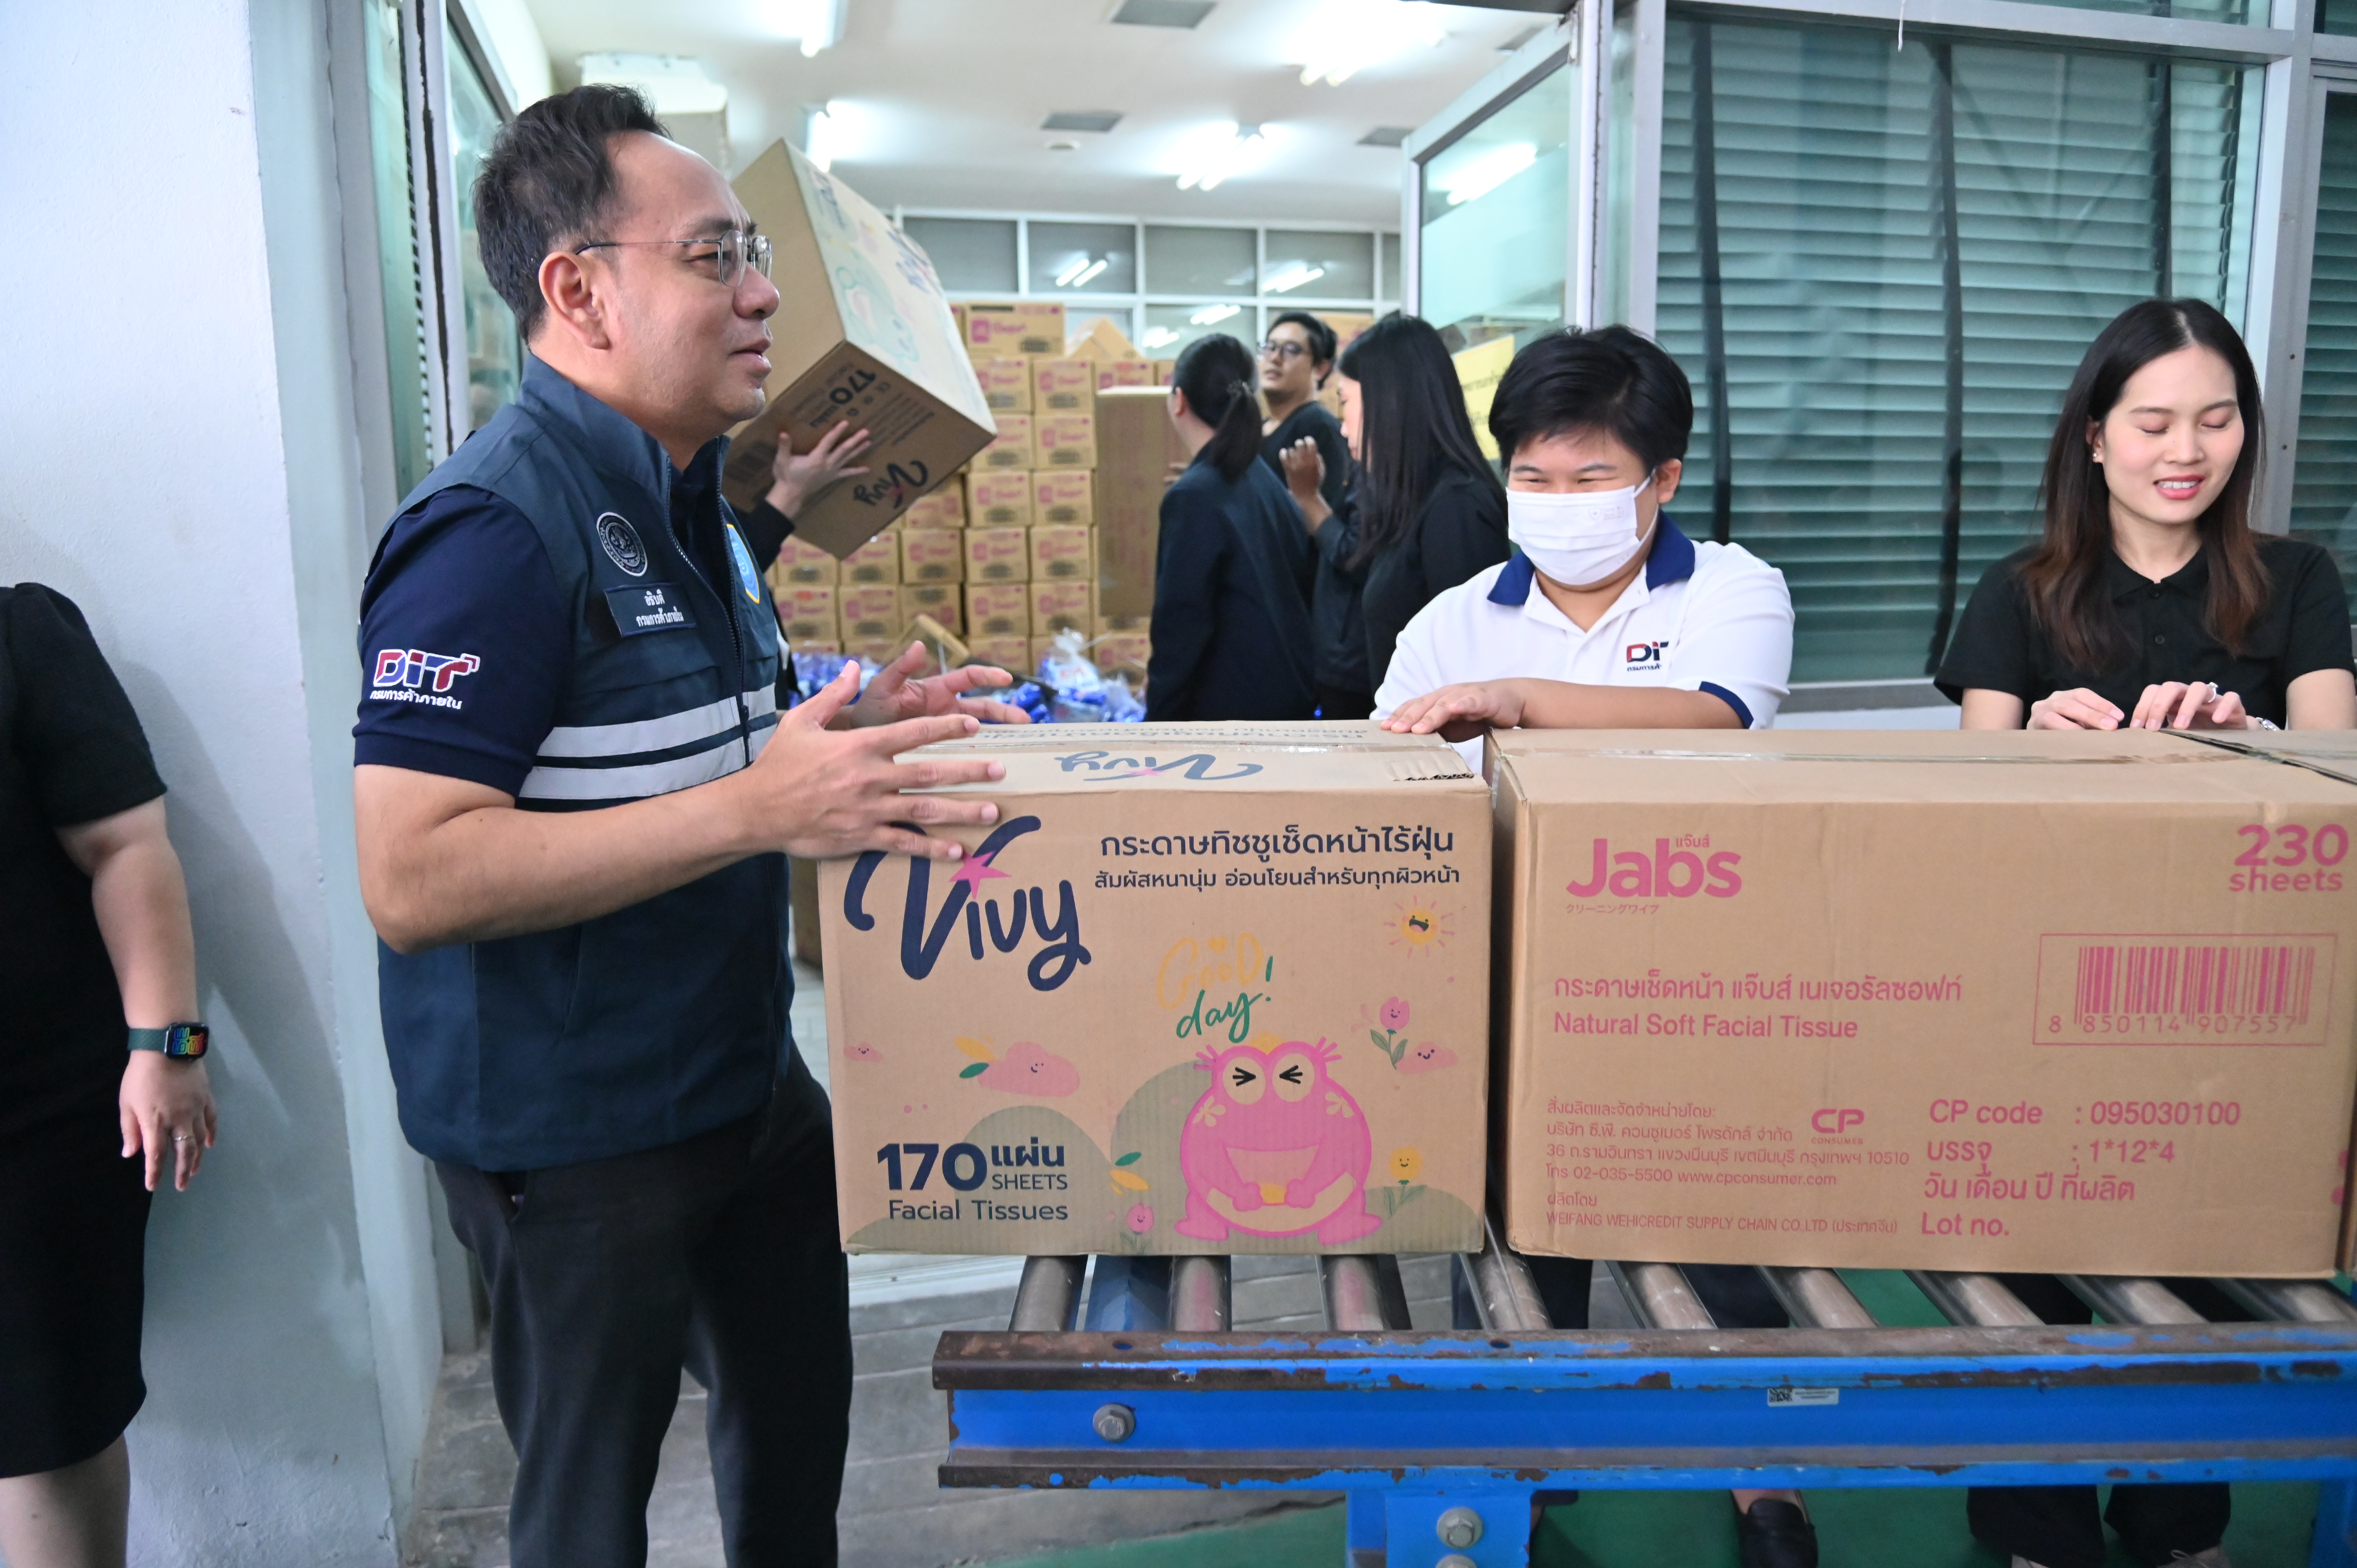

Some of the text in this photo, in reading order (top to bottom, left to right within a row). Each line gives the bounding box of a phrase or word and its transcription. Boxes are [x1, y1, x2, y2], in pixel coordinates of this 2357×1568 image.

[369, 689, 463, 710] กรมการค้าภายใน
[1054, 751, 1263, 781] Vivy
[1101, 824, 1454, 862] กระดาษทิชชูเช็ดหน้าไร้ฝุ่น
[2234, 823, 2350, 867] 230
[1095, 866, 1459, 892] สัมผัสหนานุ่ม อ่อนโยนสำหรับทุกผิวหน้า
[1566, 838, 1742, 898] Jabs
[2228, 867, 2343, 893] sheets
[844, 815, 1092, 991] Vivy
[1554, 969, 1724, 999] กระดาษเช็ดหน้า
[1800, 974, 1963, 1001] เนเจอรัลซอฟท์
[1554, 1012, 1858, 1038] Natural Soft Facial Tissue
[2048, 1015, 2062, 1033] 8
[1811, 1109, 1865, 1133] CP
[1929, 1099, 1969, 1123] CP
[1976, 1100, 2043, 1125] code
[2090, 1100, 2241, 1126] 095030100
[1546, 1143, 1565, 1157] 36
[1868, 1151, 1910, 1165] 10510
[1811, 1137, 1863, 1145] CONSUMER
[877, 1137, 1065, 1192] 170 แผ่น
[1573, 1166, 1673, 1182] 02-035-5500
[1678, 1172, 1837, 1186] www.cpconsumer.com
[992, 1174, 1068, 1190] SHEETS
[1924, 1171, 1958, 1199] วัน
[2035, 1171, 2054, 1199] ปี
[2061, 1164, 2136, 1201] ที่ผลิต
[889, 1199, 1068, 1220] Facial Tissues
[1546, 1211, 1602, 1226] WEIFANG
[1607, 1214, 1683, 1229] WEHICREDIT
[1687, 1216, 1734, 1229] SUPPLY
[1738, 1217, 1777, 1231] CHAIN
[1921, 1211, 2010, 1236] Lot no.
